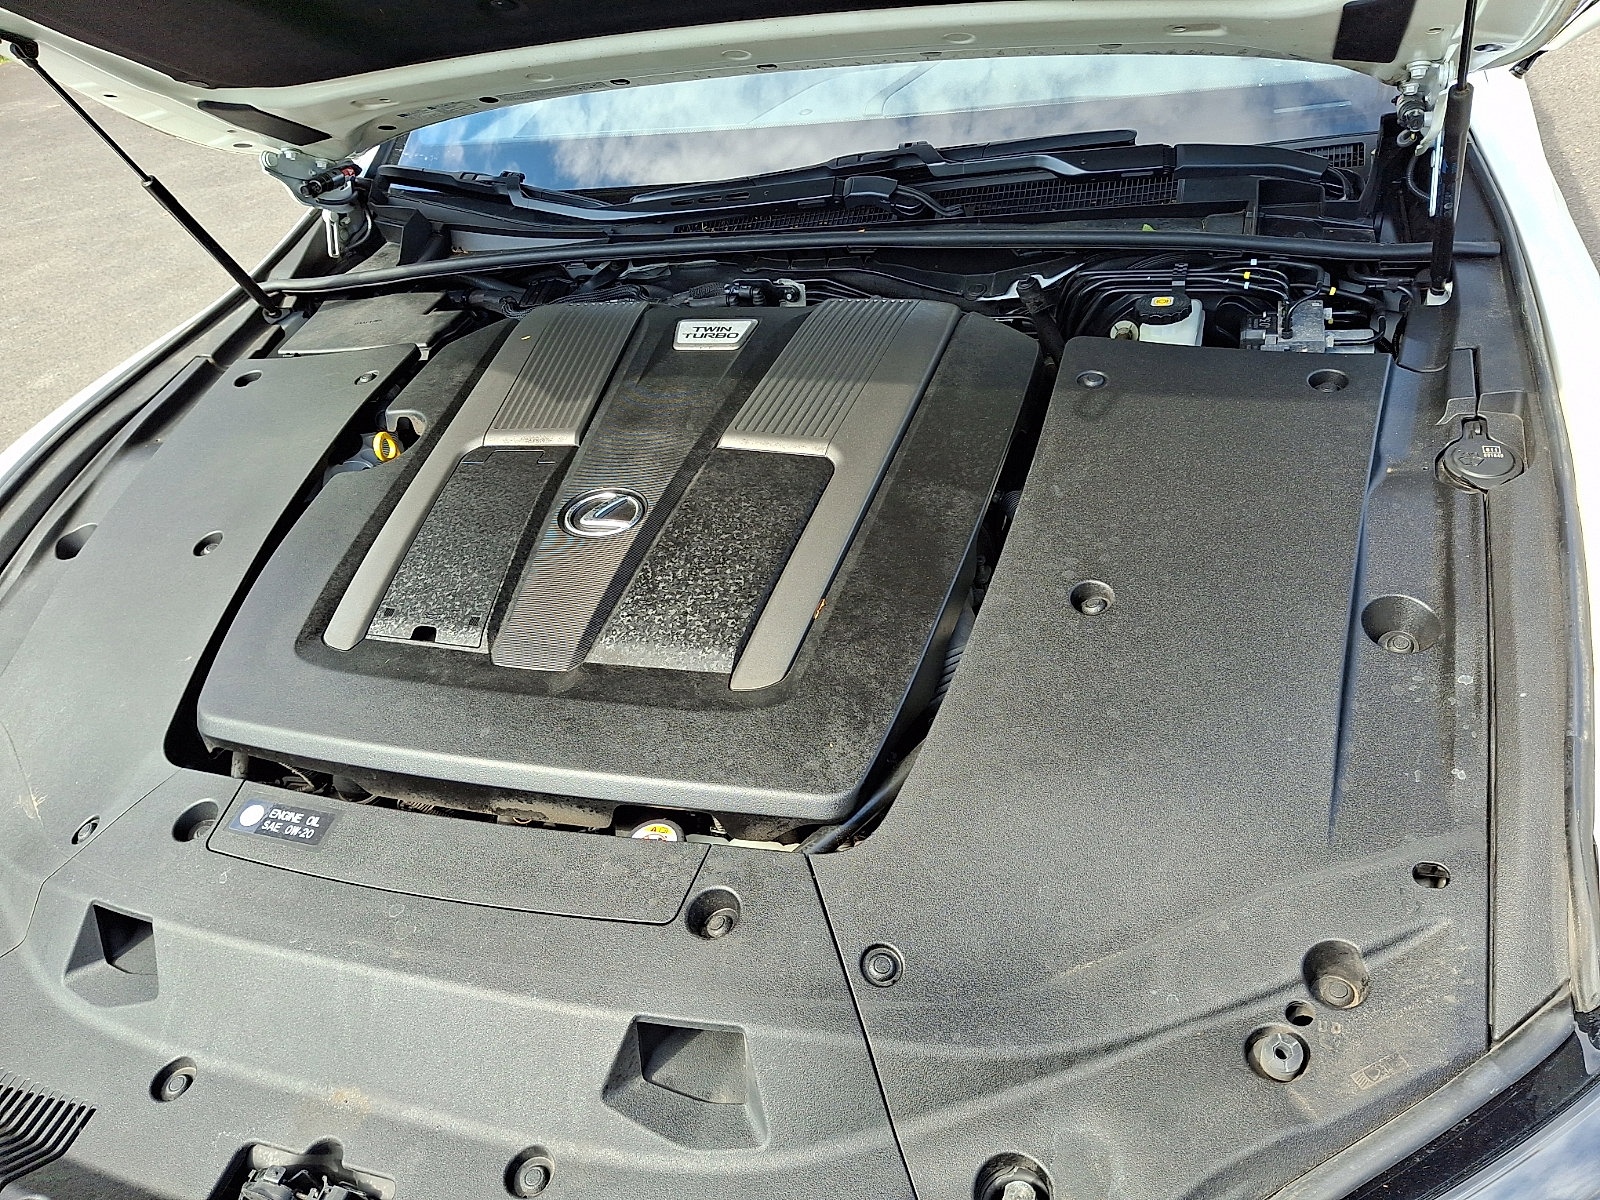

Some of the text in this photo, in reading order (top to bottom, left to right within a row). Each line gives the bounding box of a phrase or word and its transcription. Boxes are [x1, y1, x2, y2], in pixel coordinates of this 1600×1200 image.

[268, 808, 321, 828] ENGINE OIL
[261, 820, 315, 839] SAE 0W-20
